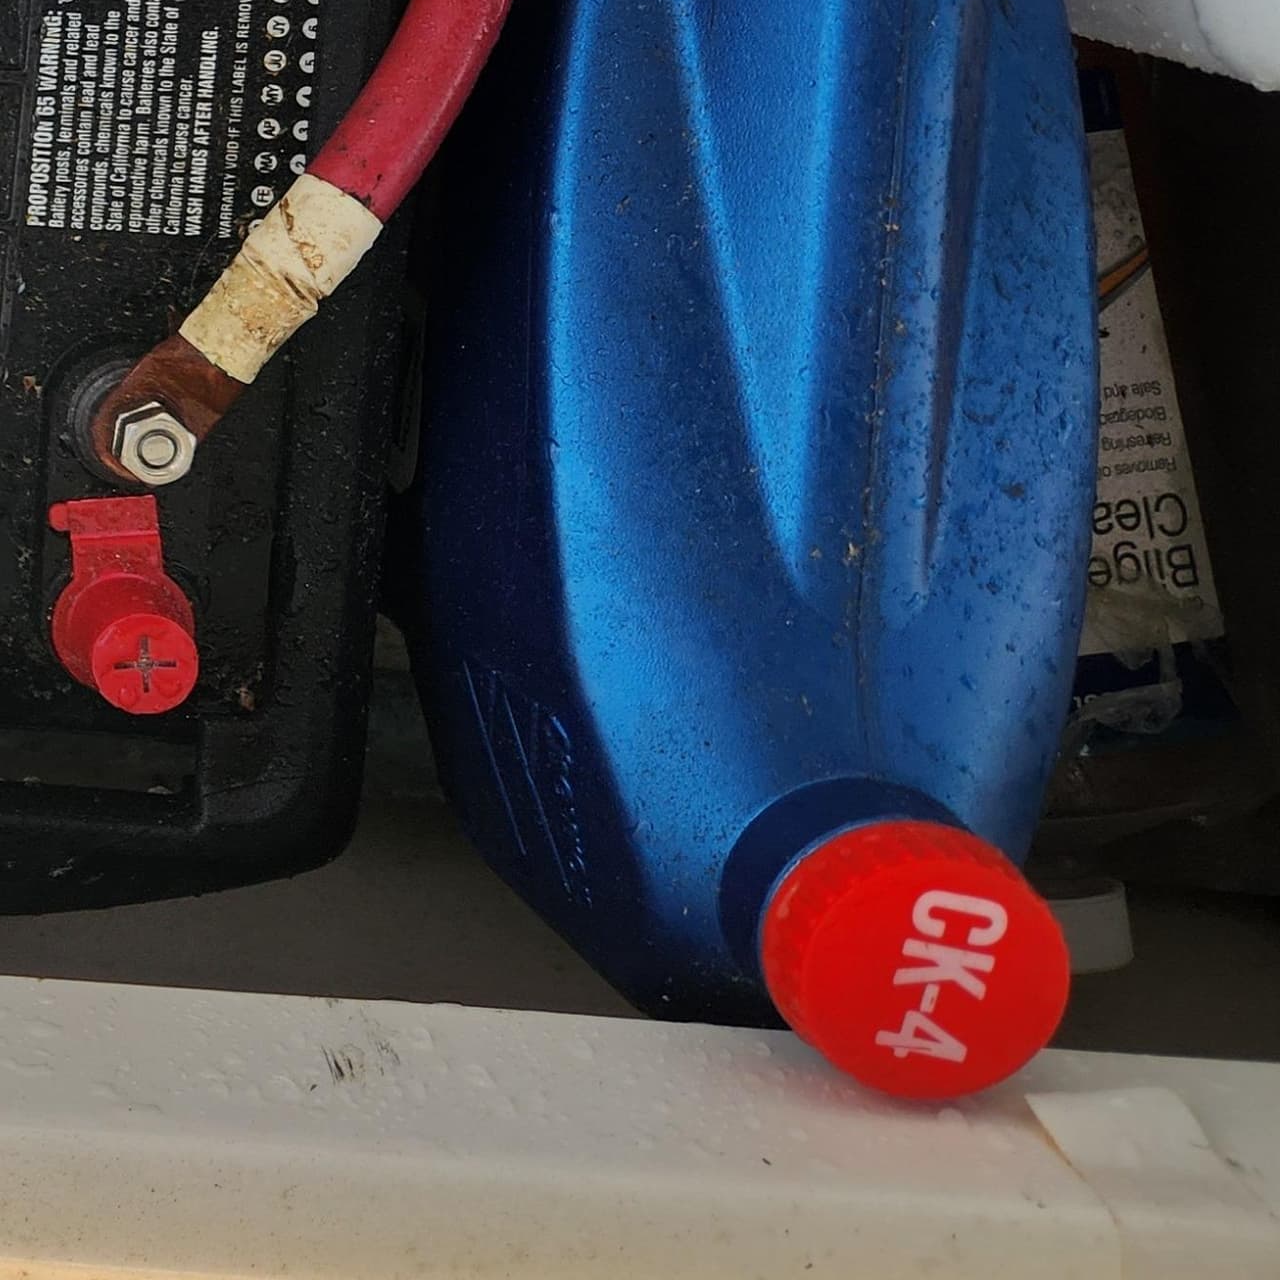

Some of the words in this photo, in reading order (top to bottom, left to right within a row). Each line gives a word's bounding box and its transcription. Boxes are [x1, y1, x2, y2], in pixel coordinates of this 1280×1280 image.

[36, 9, 63, 91] WARNING:
[63, 11, 82, 56] related
[83, 23, 100, 51] lead
[235, 41, 248, 53] IS
[62, 58, 78, 81] and
[81, 54, 98, 77] and
[196, 25, 218, 98] HANDLING.
[232, 56, 247, 93] LABEL
[35, 95, 56, 116] 65
[57, 84, 76, 143] terminals
[79, 80, 96, 107] lead
[228, 96, 243, 124] THIS
[75, 110, 93, 155] contain
[192, 101, 212, 144] AFTER
[227, 126, 240, 136] IF
[26, 120, 54, 226] PROPOSITION
[188, 147, 208, 194] HANDS
[224, 140, 239, 169] VOID
[48, 184, 71, 228] Battery
[69, 157, 89, 229] accessories
[218, 172, 236, 238] WARRANTY
[185, 197, 204, 236] WASH
[1132, 380, 1161, 397] Safe
[1115, 455, 1176, 475] Removes
[1088, 542, 1200, 589] Bilge
[874, 889, 1008, 1063] CK-4
